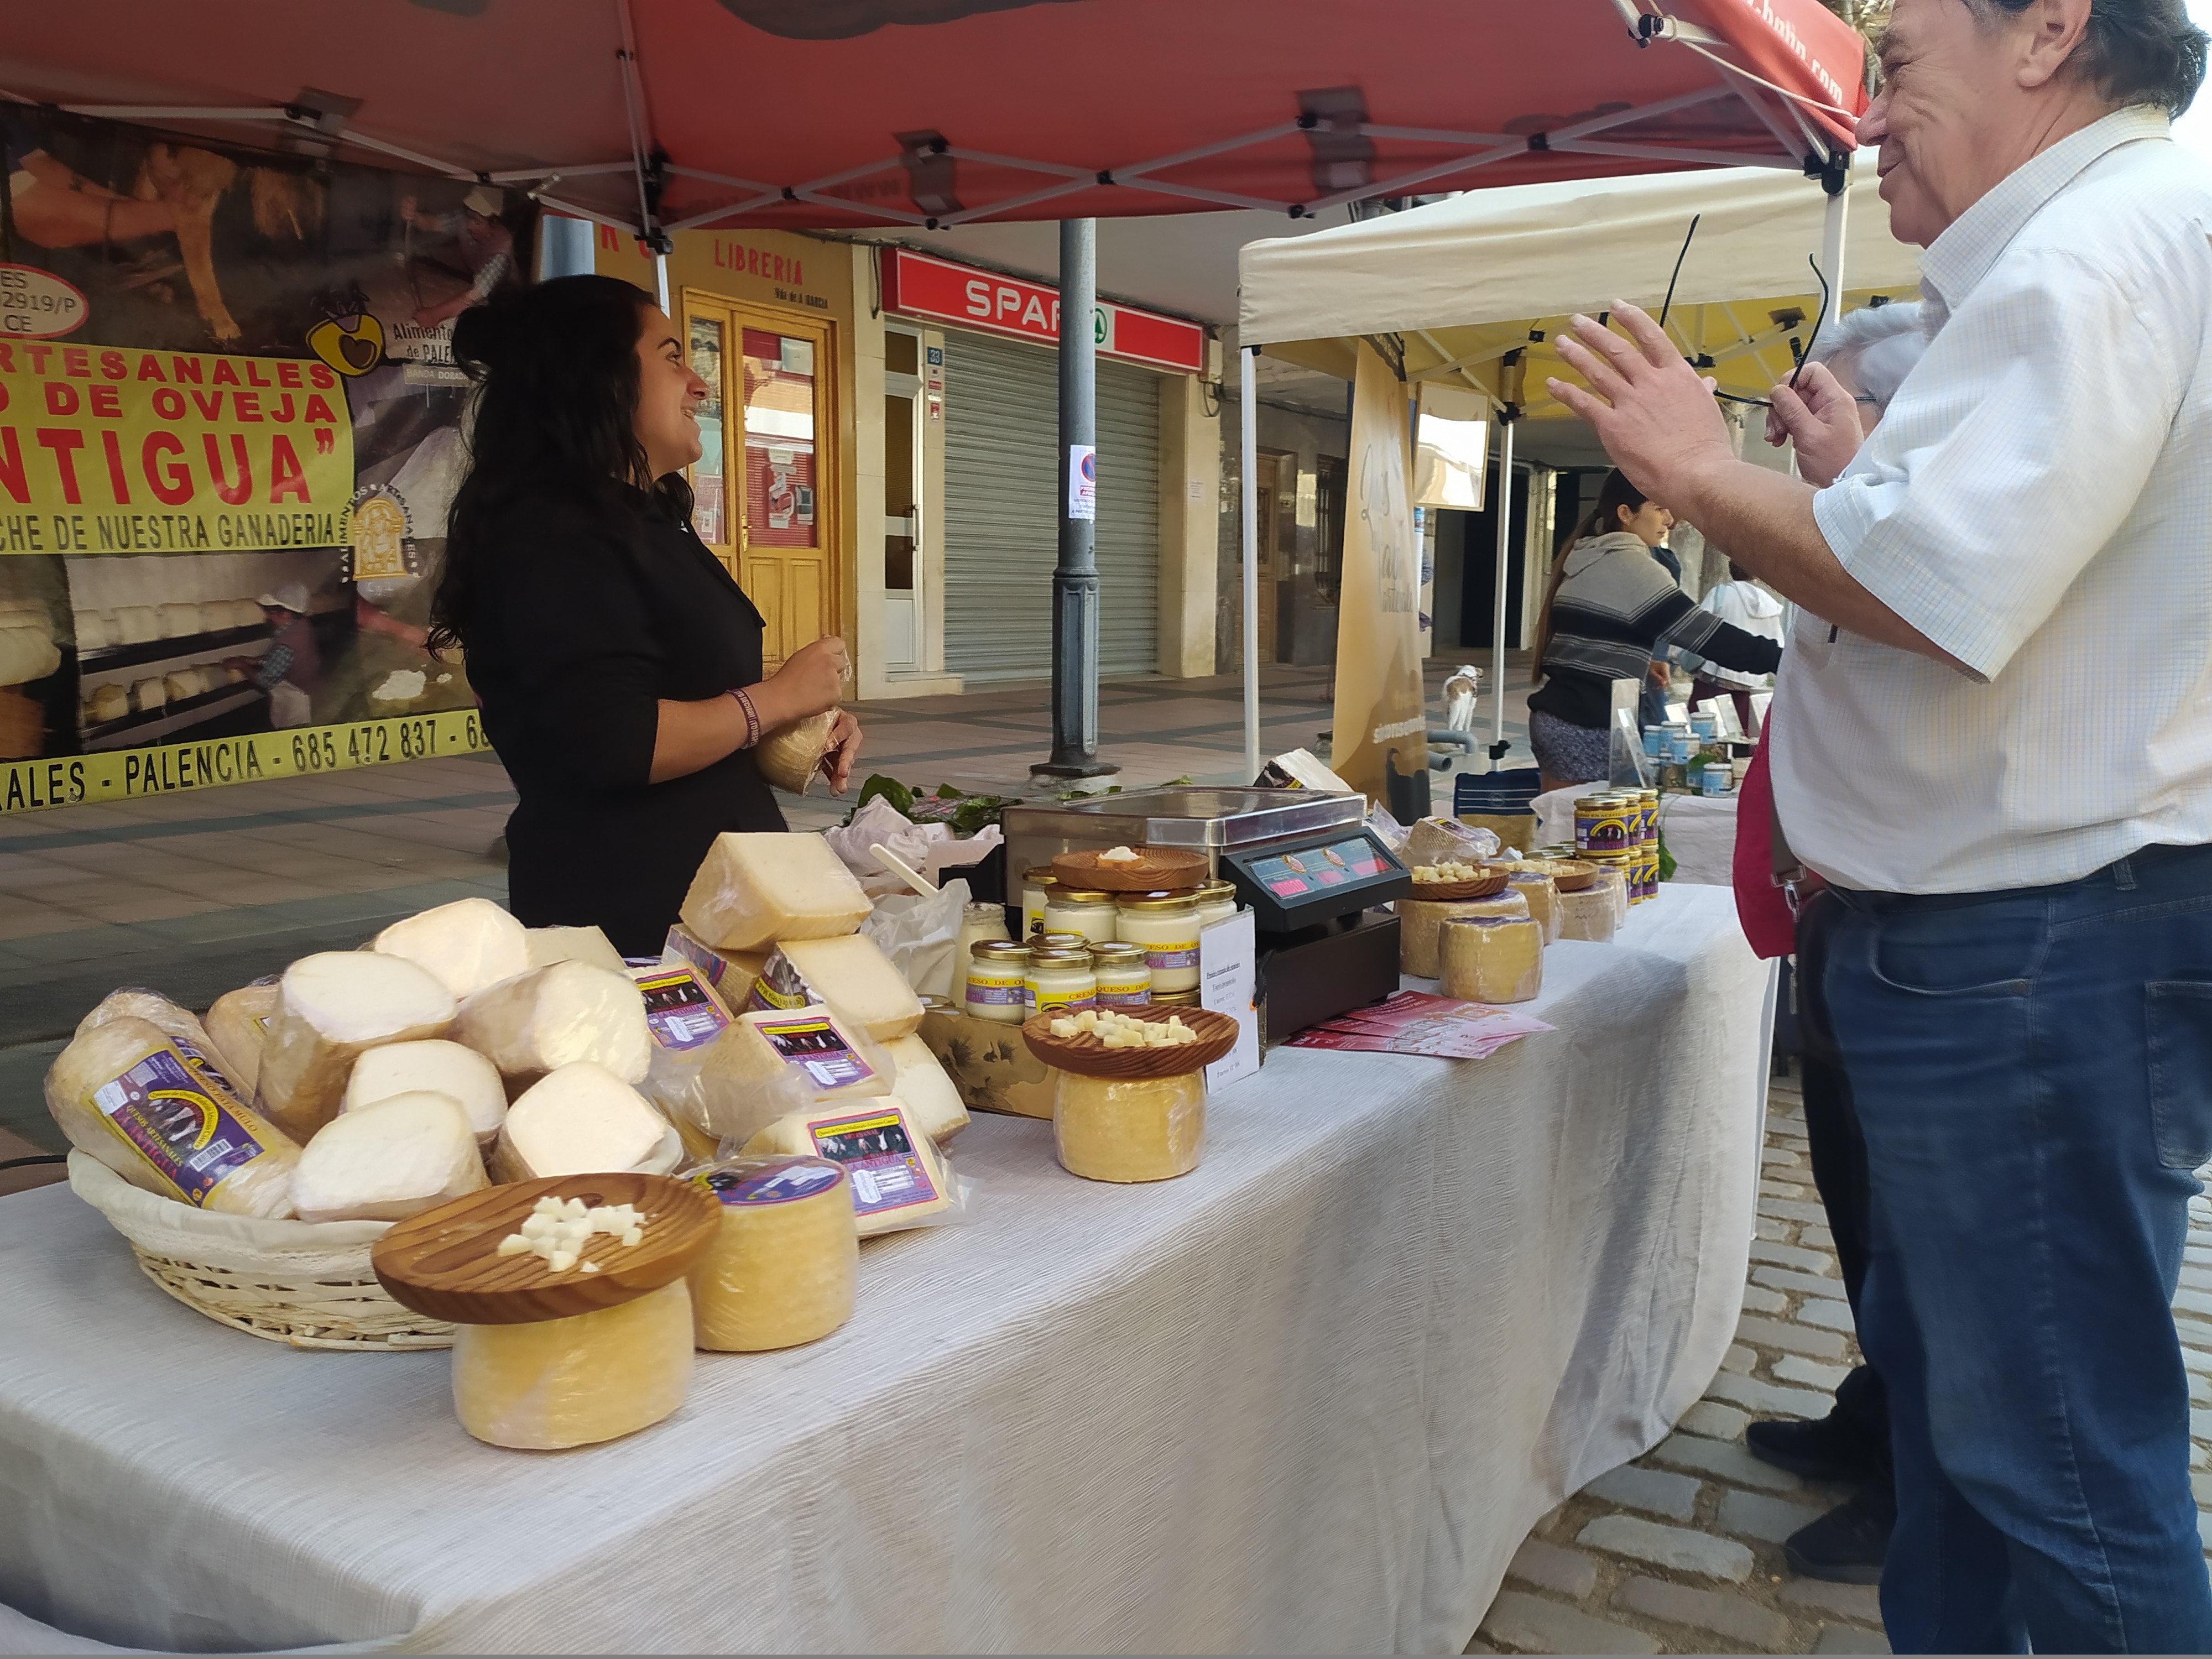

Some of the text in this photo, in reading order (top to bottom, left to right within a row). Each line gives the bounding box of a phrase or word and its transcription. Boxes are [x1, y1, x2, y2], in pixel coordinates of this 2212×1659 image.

[1, 270, 28, 289] ES
[714, 239, 803, 285] LIBRERIA
[4, 314, 32, 332] CE
[393, 322, 455, 341] Alimento
[0, 343, 335, 389] RTESANALES
[45, 382, 123, 418] DE
[152, 388, 337, 423] OVEJA
[54, 514, 91, 550] DE
[97, 514, 211, 549] NUESTRA
[217, 513, 335, 547] GANADERIA
[0, 761, 85, 811] ALES
[126, 739, 262, 795] PALENCIA
[291, 732, 335, 772] 685
[348, 725, 390, 764] 472
[400, 719, 436, 758] 837
[127, 1105, 149, 1126] QUESOS
